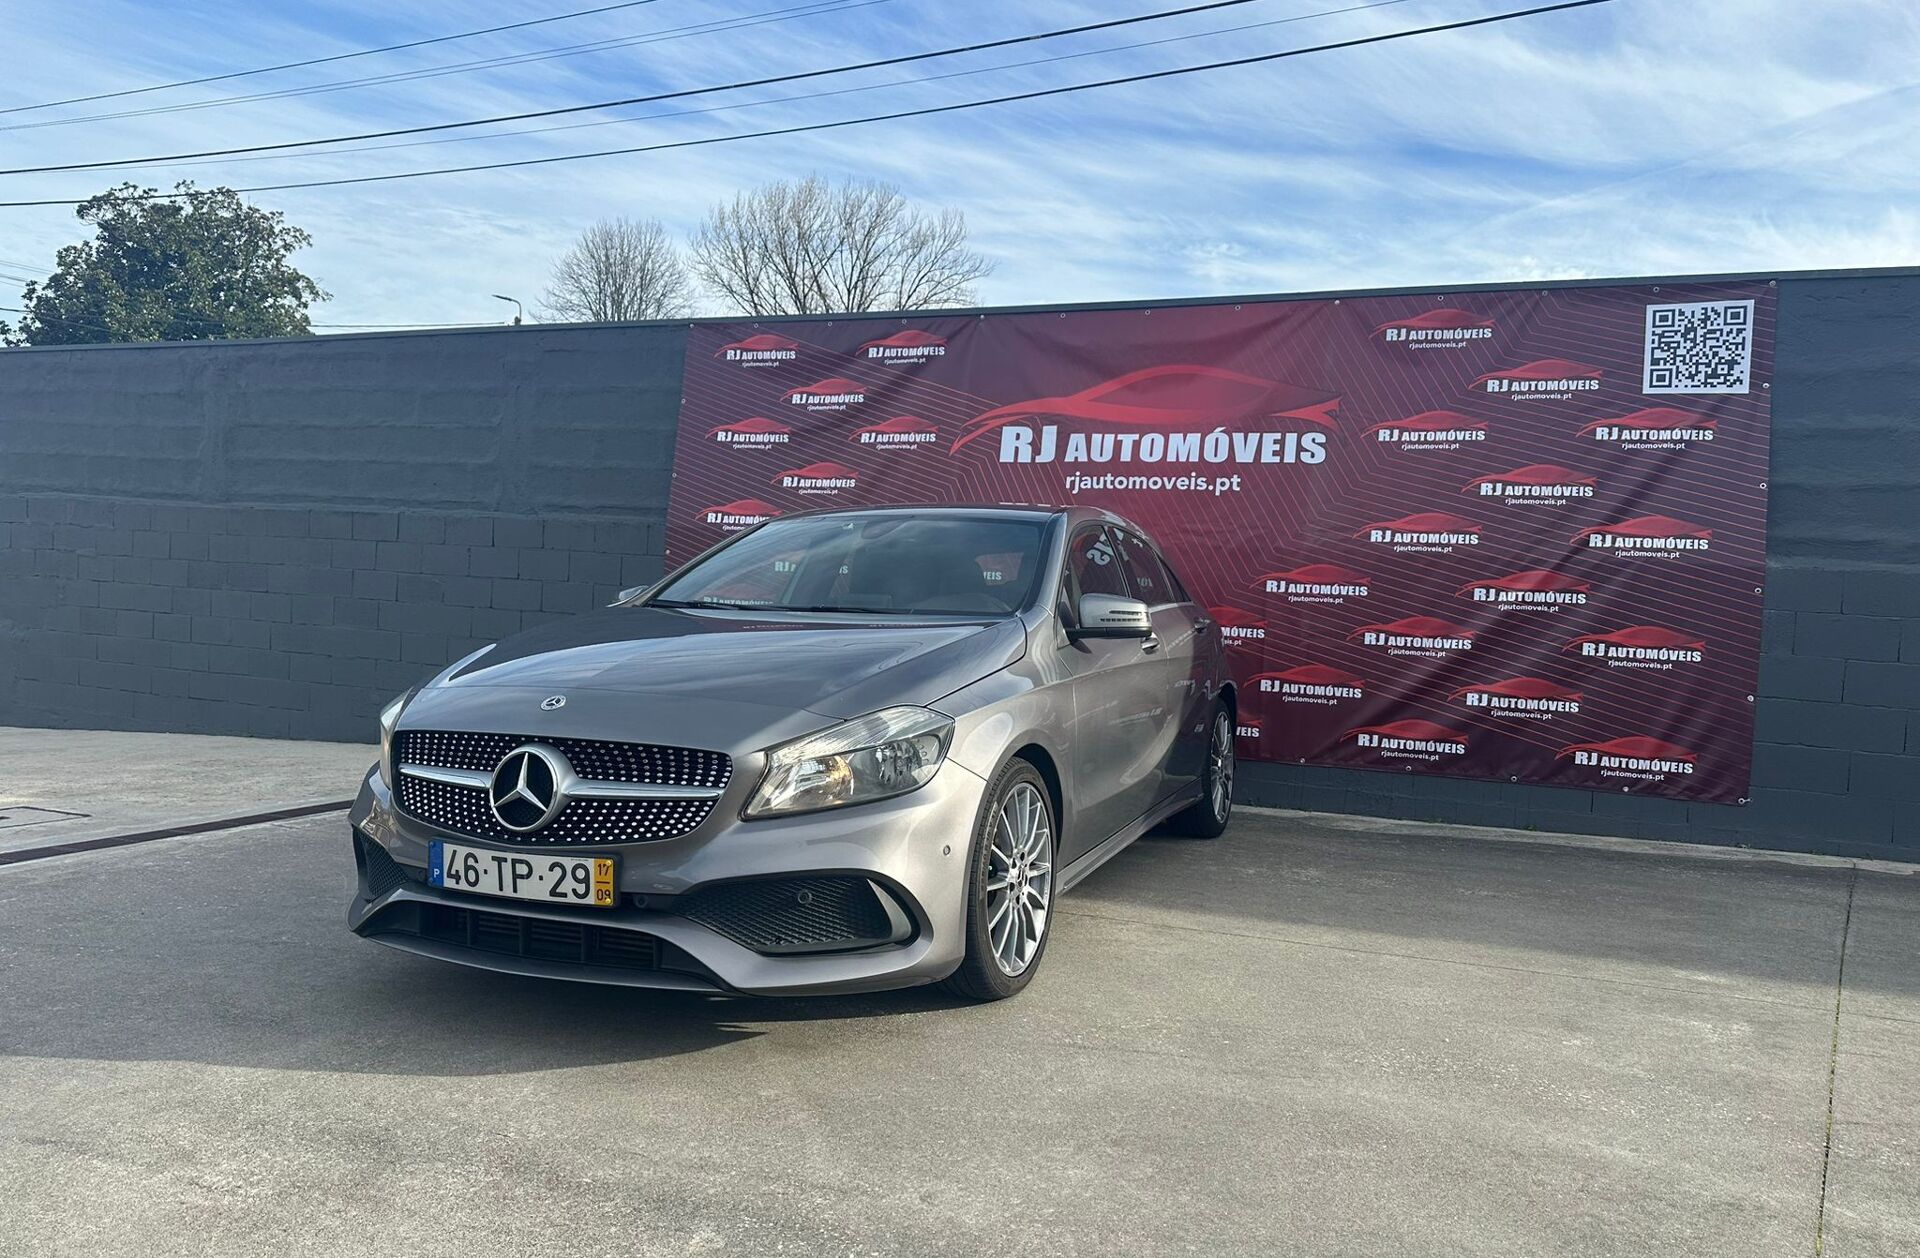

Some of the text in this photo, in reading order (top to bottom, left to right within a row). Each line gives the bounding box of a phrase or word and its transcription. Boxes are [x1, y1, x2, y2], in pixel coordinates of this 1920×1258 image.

[1386, 327, 1492, 341] RJ AUTOMÓVEIS
[1409, 341, 1466, 350] rjautomoveis.pt
[727, 349, 795, 360] RJ AUTOMÓVEIS
[869, 346, 944, 358] RJ AUTOMÓVEIS
[1487, 379, 1599, 392] RJ AUTOMÓVEIS
[792, 394, 864, 404] RJ AUTOMÓVEIS
[1512, 393, 1571, 401] rjautomoveis.pt
[717, 431, 789, 442] RJ AUTOMÓVEIS
[861, 433, 936, 443] RJ AUTOMÓVEIS
[1378, 428, 1485, 441] RJ AUTOMÓVEIS
[1596, 427, 1713, 441] RJ AUTOMÓVEIS
[999, 425, 1327, 463] RJ AUTOMÓVEIS
[1622, 441, 1685, 450] rjautomoveis.pt
[783, 477, 855, 487] RJ AUTOMÓVEIS
[1066, 473, 1241, 496] rjautomoveis.pt
[1480, 483, 1593, 497] RJ AUTOMÓVEIS
[1505, 497, 1566, 506] rjautomoveis.pt
[707, 513, 722, 523] RJ
[1371, 530, 1478, 545] RJ AUTOMÓVEIS
[1589, 534, 1708, 549] RJ AUTOMÓVEIS
[1394, 545, 1452, 553] rjautomoveis.pt
[1616, 550, 1679, 559] rjautomoveis.pt
[1266, 580, 1368, 596] RJ AUTOMÓVEIS
[1288, 595, 1343, 604] rjautomoveis.pt
[1474, 587, 1586, 605] RJ AUTOMÓVEIS
[1498, 603, 1558, 613] rjautomoveis.pt
[1221, 626, 1265, 639] MÓVEIS
[1364, 632, 1472, 650] RJ AUTOMÓVEIS
[1388, 648, 1446, 658] rjautomoveis.pt
[1582, 643, 1701, 662] RJ AUTOMÓVEIS
[1608, 660, 1672, 670] rjautomoveis.pt
[1260, 680, 1362, 698] RJ AUTOMÓVEIS
[1282, 695, 1337, 705] rjautomoveis.pt
[1466, 693, 1579, 713] RJ AUTOMÓVEIS
[1491, 709, 1552, 720] rjautomoveis.pt
[1358, 734, 1465, 754] RJ AUTOMÓVEIS
[1381, 750, 1438, 761] rjautomoveis.pt
[1575, 752, 1693, 773] RJ AUTOMÓVEIS
[1601, 770, 1664, 781] rjautomoveis.pt
[433, 868, 440, 878] P
[597, 863, 611, 876] 17
[596, 888, 611, 901] 09
